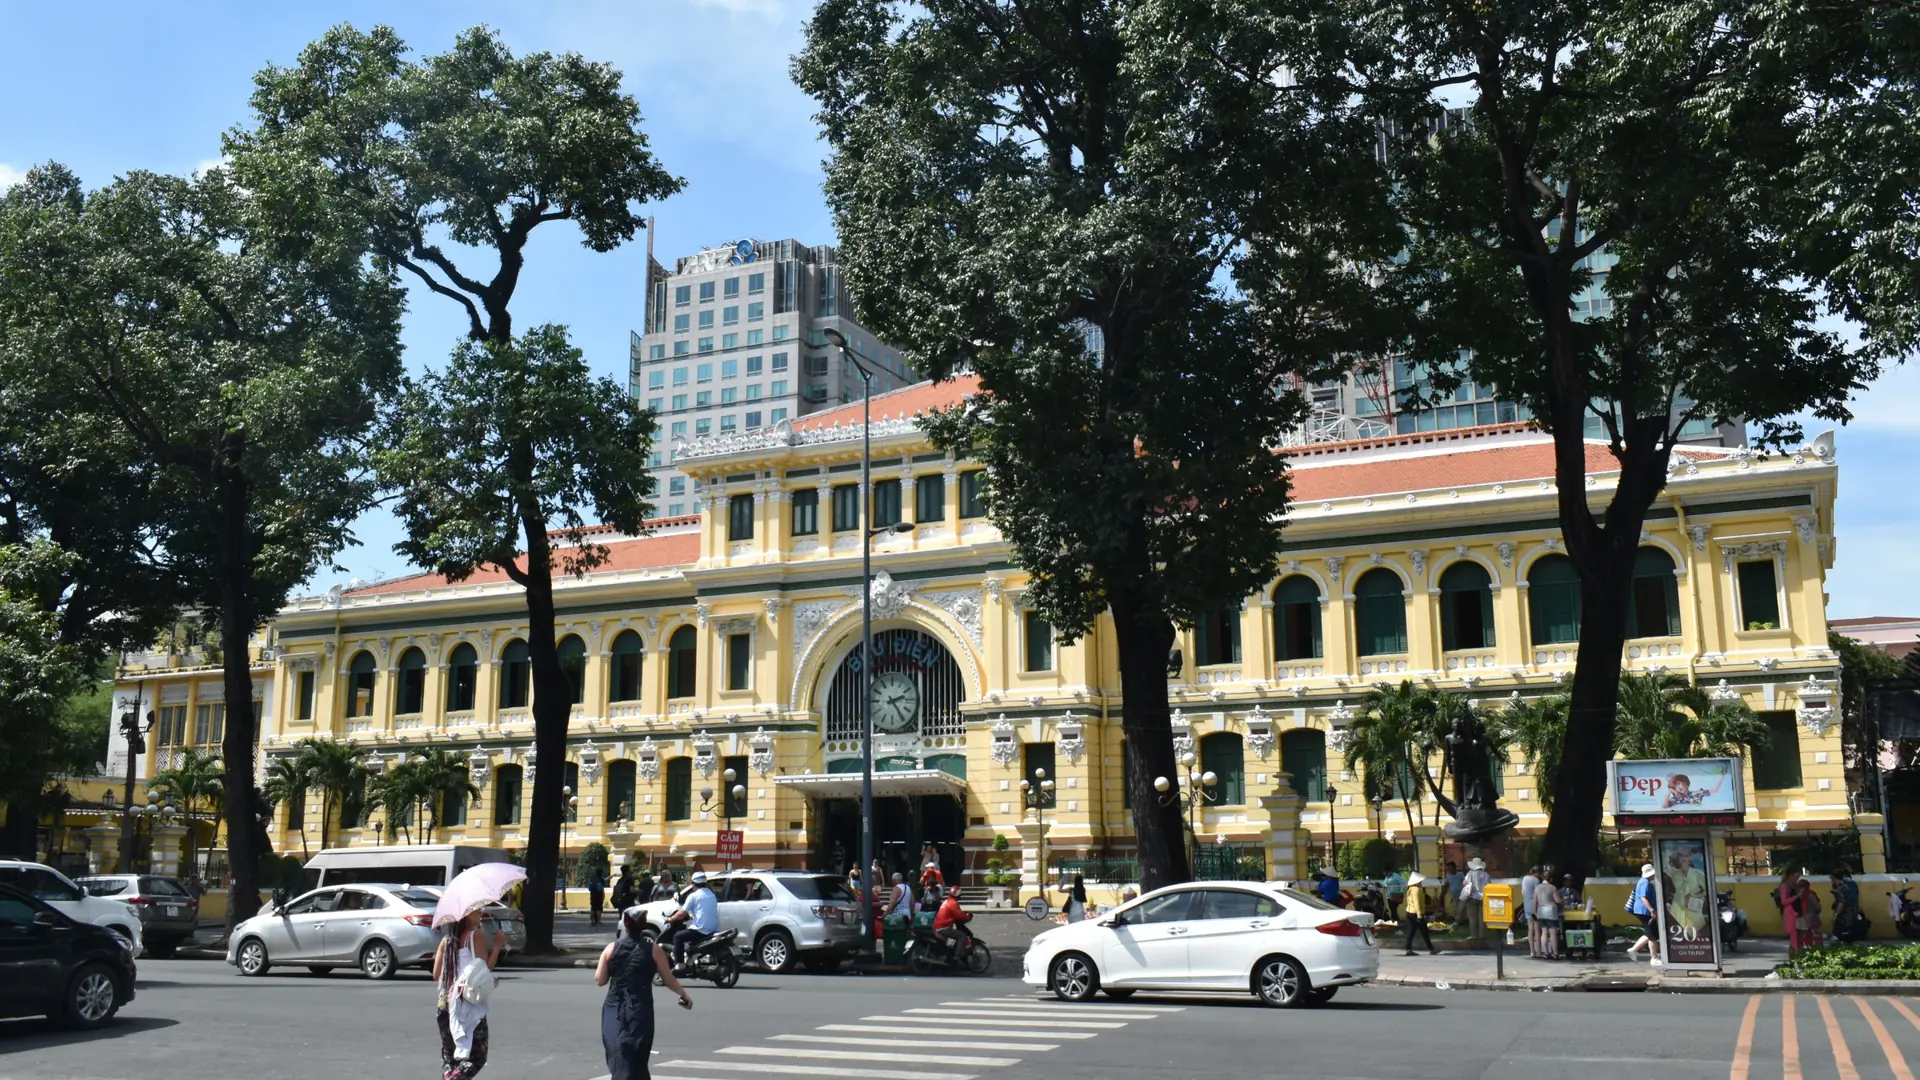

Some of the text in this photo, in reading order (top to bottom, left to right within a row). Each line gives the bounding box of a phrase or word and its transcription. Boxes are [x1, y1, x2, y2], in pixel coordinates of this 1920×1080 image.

[680, 249, 733, 276] ANZ
[1620, 776, 1662, 796] Đẹp
[720, 832, 740, 842] CẤM
[1670, 924, 1697, 942] 20
